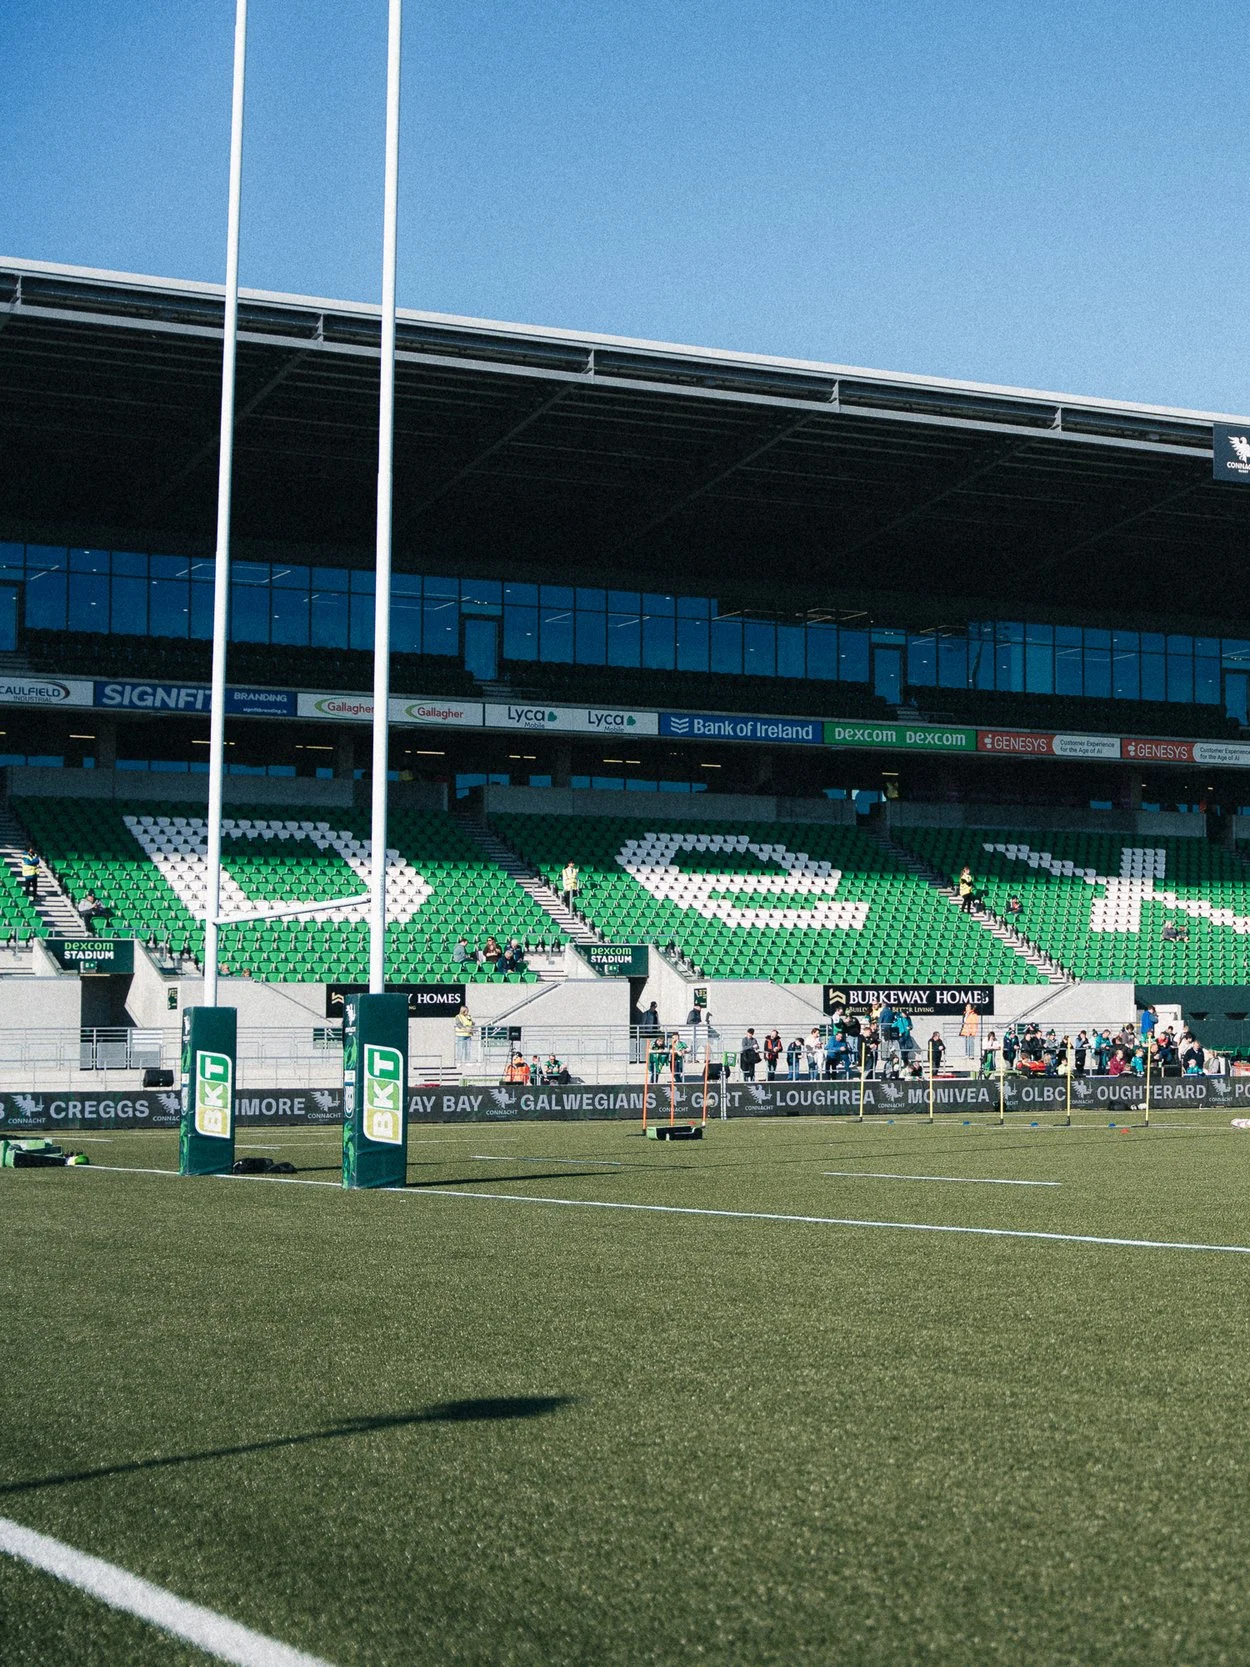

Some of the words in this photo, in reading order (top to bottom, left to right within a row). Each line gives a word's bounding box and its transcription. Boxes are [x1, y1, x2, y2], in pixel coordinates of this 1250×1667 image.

[0, 685, 60, 697] CAULFIELD
[234, 692, 287, 702] BRANDING
[327, 702, 374, 714] Gallagher
[418, 706, 464, 720] Gallagher
[508, 706, 545, 722] Lyca
[588, 711, 624, 727] Lyca
[694, 718, 734, 735] Bank
[736, 721, 754, 736] of
[757, 722, 812, 739] Ireland
[994, 736, 1047, 751] GENESYS
[1086, 740, 1115, 748] Experience
[1137, 744, 1188, 758] GENESYS
[1200, 746, 1222, 754] Customer
[1224, 748, 1250, 756] Experience
[64, 951, 114, 960] STADIUM
[590, 955, 632, 963] STADIUM
[418, 993, 461, 1004] HOMES
[849, 990, 930, 1004] BURKEWAY
[936, 990, 989, 1004] HOMES
[204, 1056, 224, 1132] BKT
[373, 1052, 394, 1138] BKT
[776, 1090, 875, 1106] LOUGHREA
[908, 1088, 990, 1104] MONIVEA
[1022, 1087, 1066, 1102] OLBC
[1097, 1085, 1206, 1101] OUGHTERARD
[50, 1100, 149, 1118] CREGGS
[442, 1096, 483, 1112] BAY
[521, 1093, 656, 1110] GALWEGIANS
